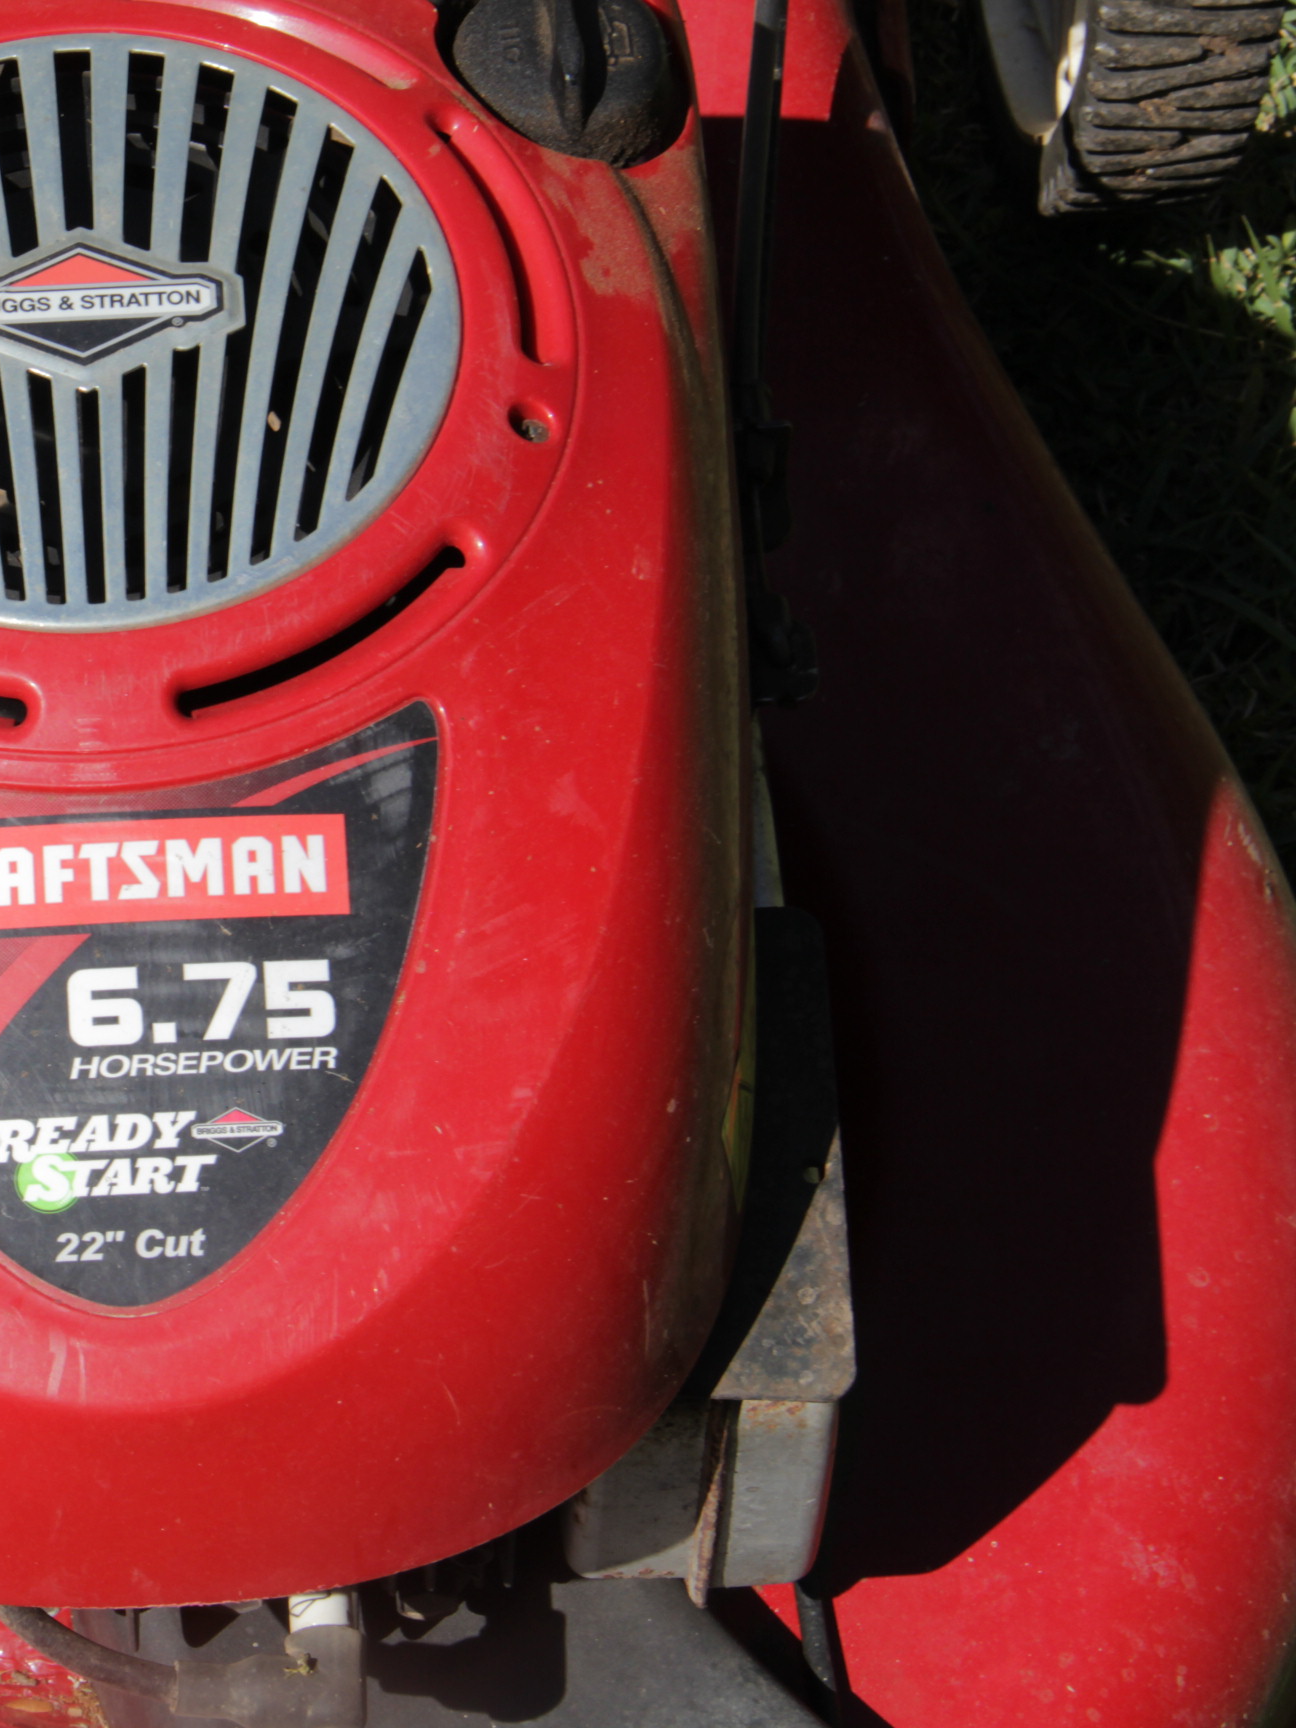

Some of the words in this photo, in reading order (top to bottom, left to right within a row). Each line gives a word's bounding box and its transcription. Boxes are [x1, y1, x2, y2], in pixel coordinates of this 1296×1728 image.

[59, 296, 74, 311] &
[81, 290, 201, 309] STRATTON
[67, 958, 337, 1047] 6.75
[70, 1047, 338, 1080] HORSEPOWER
[196, 1126, 228, 1135] BRIGGS
[228, 1125, 236, 1134] &
[236, 1124, 278, 1134] STRATTON
[22, 1153, 217, 1202] START
[55, 1230, 125, 1262] 22"
[135, 1228, 206, 1259] Cut
